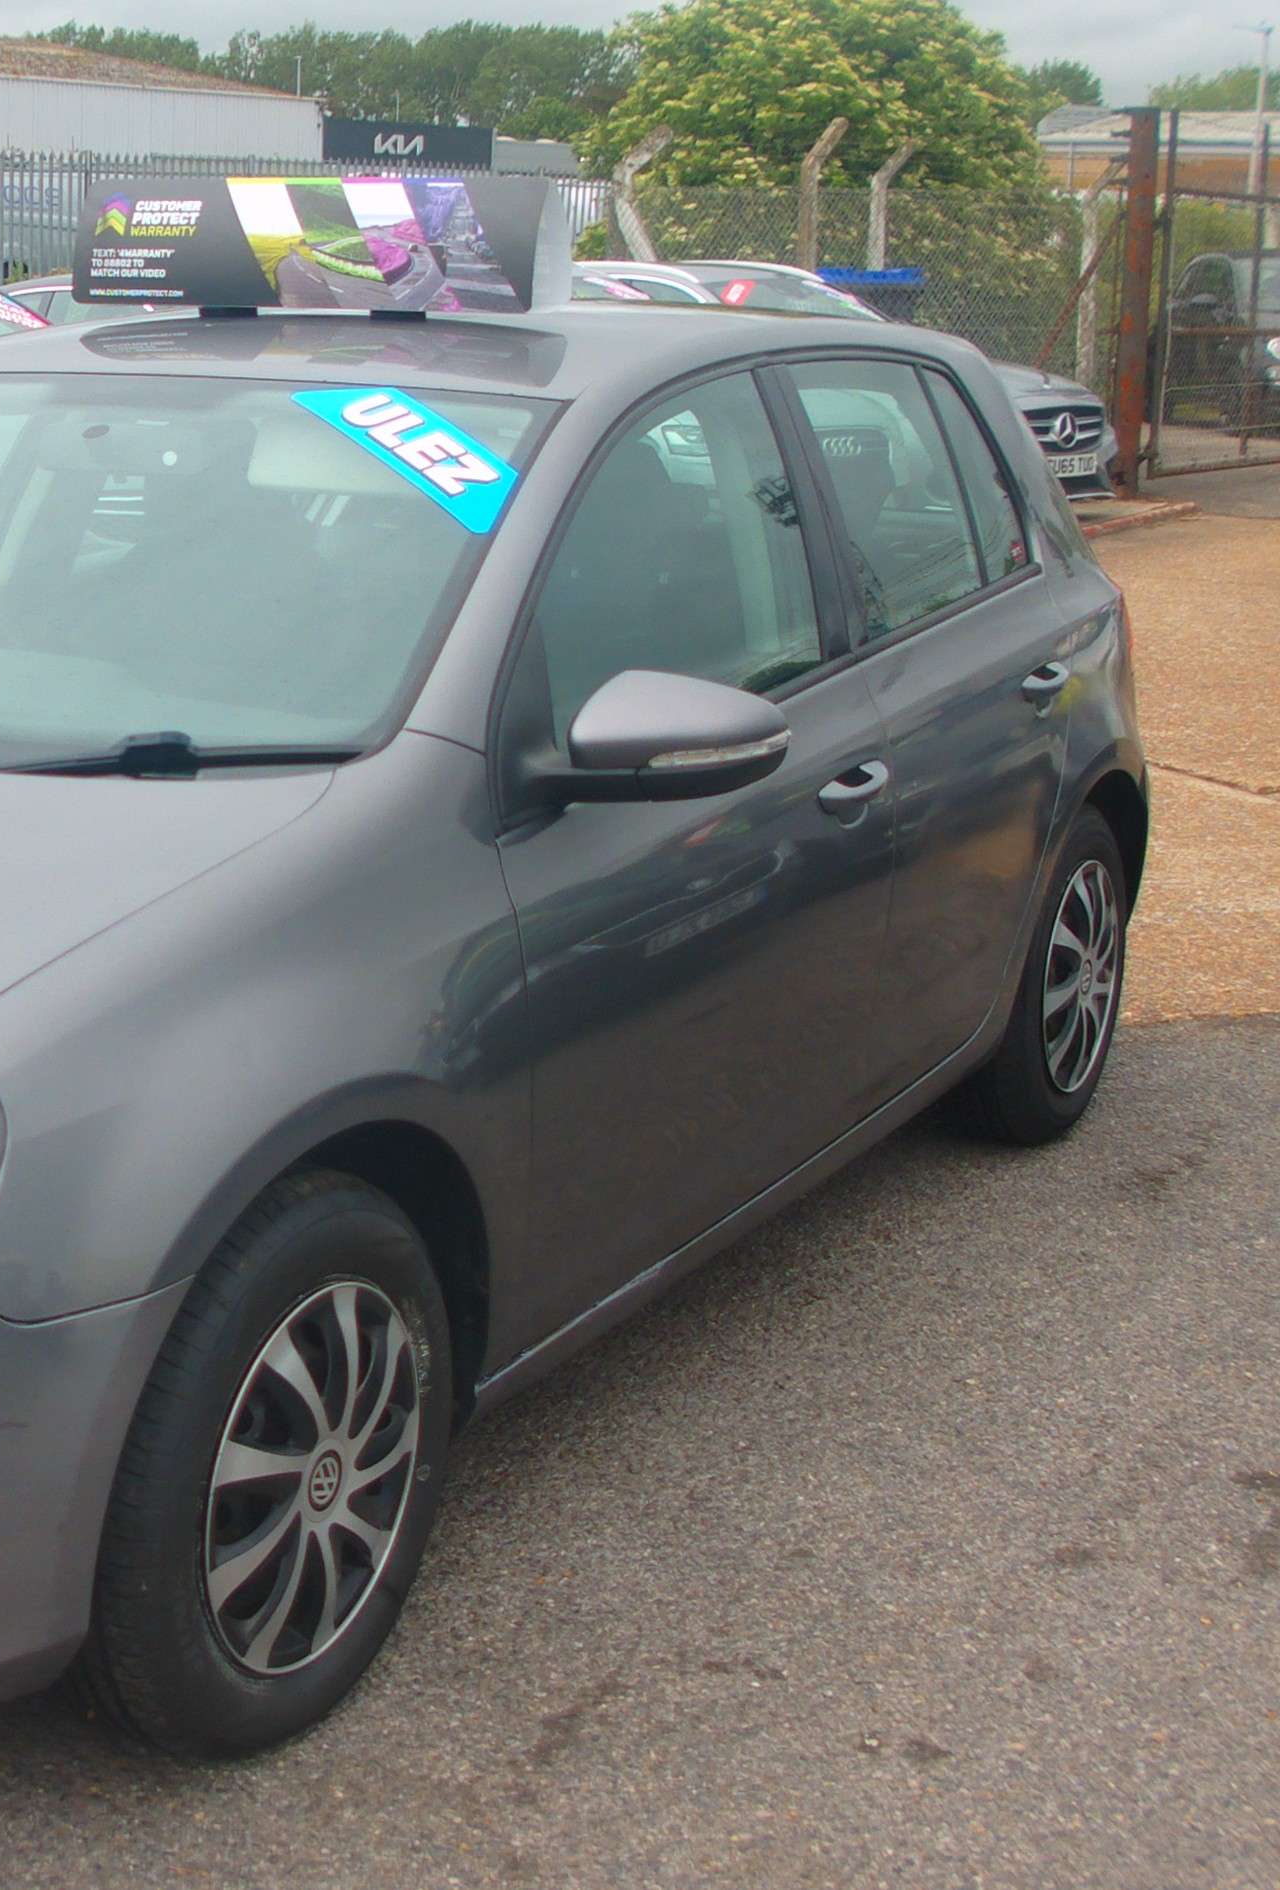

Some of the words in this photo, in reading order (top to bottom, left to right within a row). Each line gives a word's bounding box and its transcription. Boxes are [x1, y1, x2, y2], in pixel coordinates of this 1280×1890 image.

[135, 200, 203, 212] CUSTOMER
[132, 212, 201, 225] PROTECT
[130, 226, 196, 237] WARRANTY
[133, 259, 144, 268] TO
[140, 269, 166, 278] VIDEO
[342, 394, 501, 497] ULEZ
